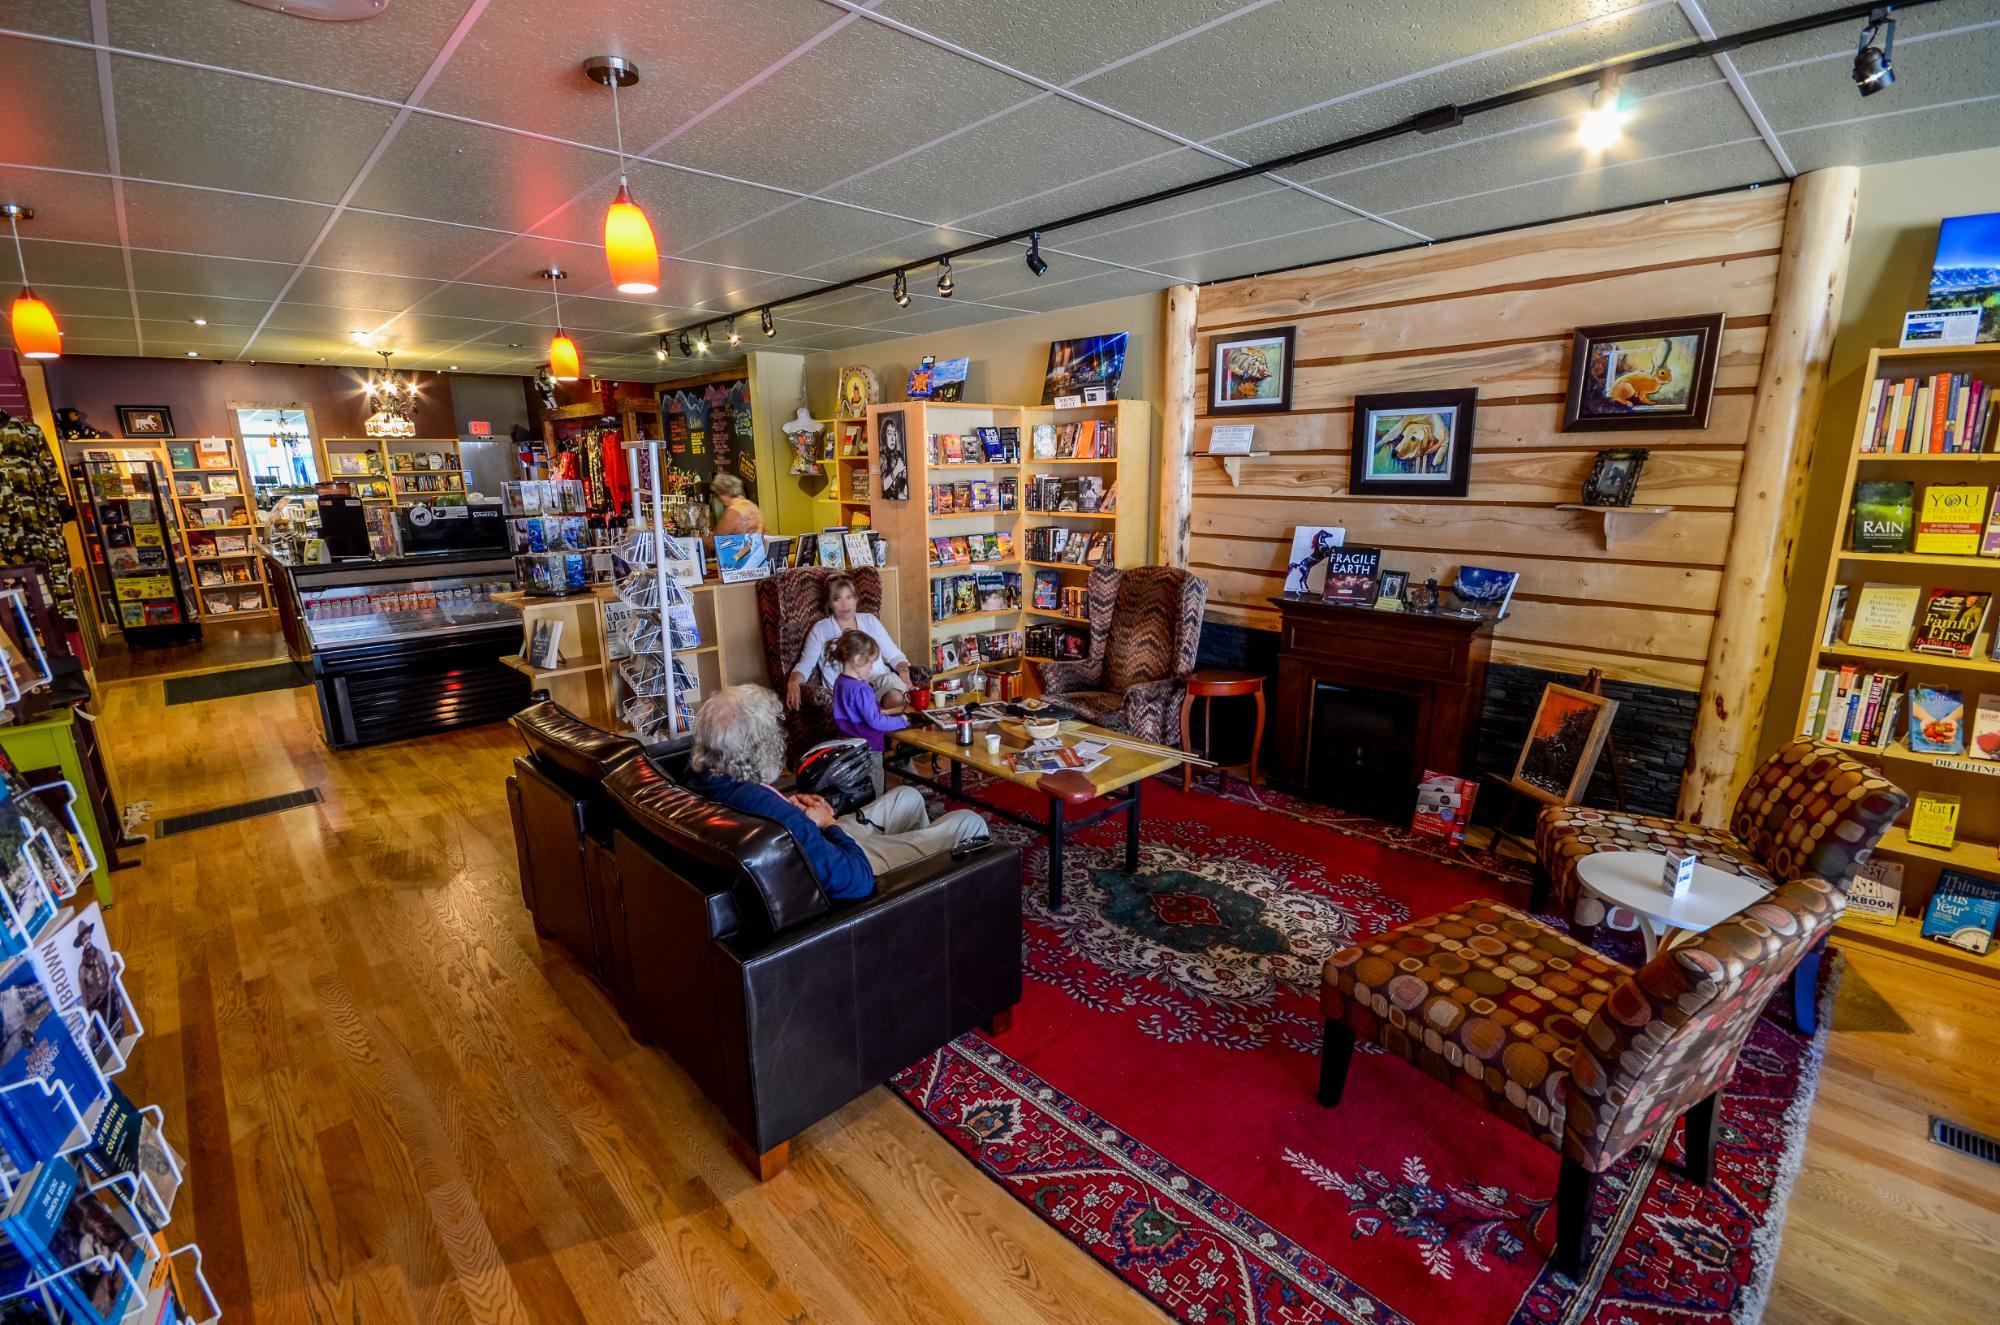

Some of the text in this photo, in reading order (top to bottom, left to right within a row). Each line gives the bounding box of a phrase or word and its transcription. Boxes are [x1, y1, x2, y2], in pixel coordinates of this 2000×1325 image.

[1931, 494, 1980, 507] YOU
[1863, 520, 1904, 533] RAIN
[1330, 553, 1376, 565] FRAGILE
[1332, 563, 1370, 574] EARTH
[1923, 613, 1974, 633] Family
[1928, 626, 1967, 642] First
[1936, 758, 2000, 774] DIET/FITNE
[1919, 800, 1947, 814] Flat
[1943, 874, 2000, 900] Thinner
[1846, 894, 1895, 909] OKBOOK
[1939, 886, 1969, 905] This
[42, 941, 74, 1005] BROWN
[102, 1102, 119, 1135] BRITISH
[106, 1113, 128, 1155] COLUMBIA
